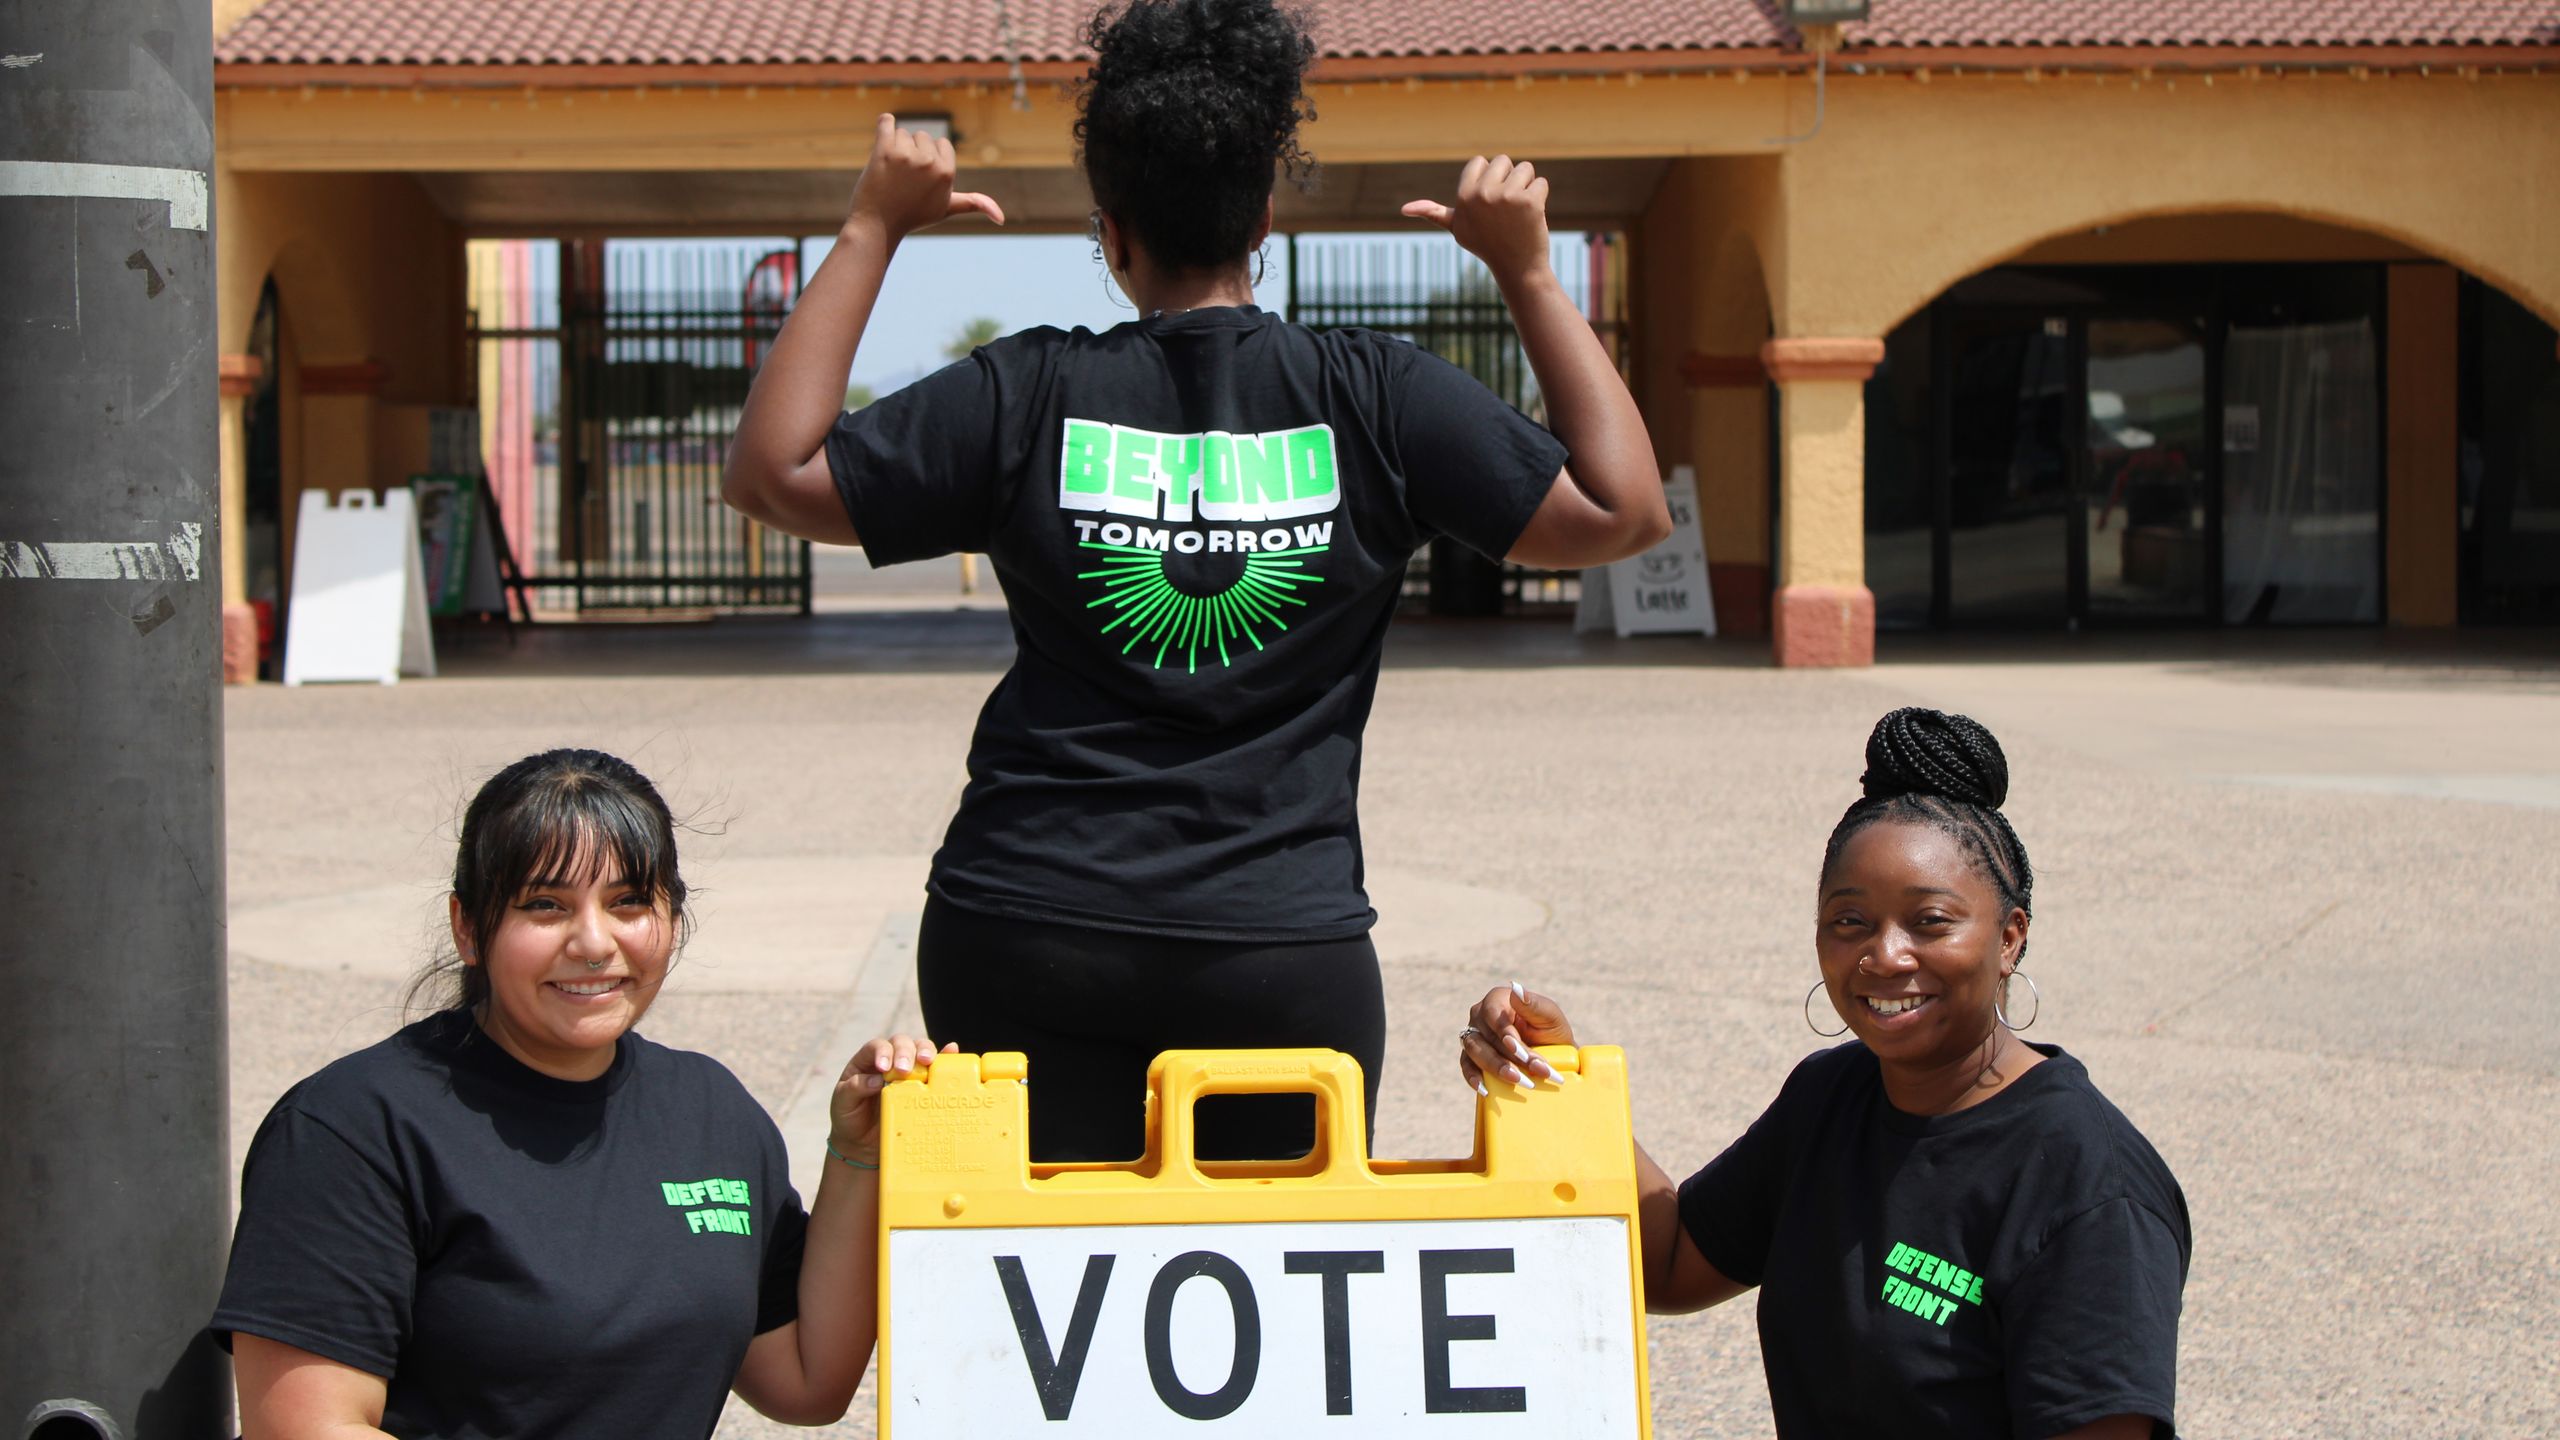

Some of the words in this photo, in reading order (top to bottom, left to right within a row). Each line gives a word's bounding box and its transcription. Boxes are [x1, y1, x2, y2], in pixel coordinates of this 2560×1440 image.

[1060, 418, 1340, 521] BEYOND
[1074, 519, 1334, 554] TOMORROW
[661, 1178, 751, 1207] DEFENSE
[684, 1208, 752, 1236] FRONT
[1884, 1241, 1984, 1306] DEFENSE
[1881, 1274, 1959, 1326] FRONT
[993, 1248, 1527, 1421] VOTE
